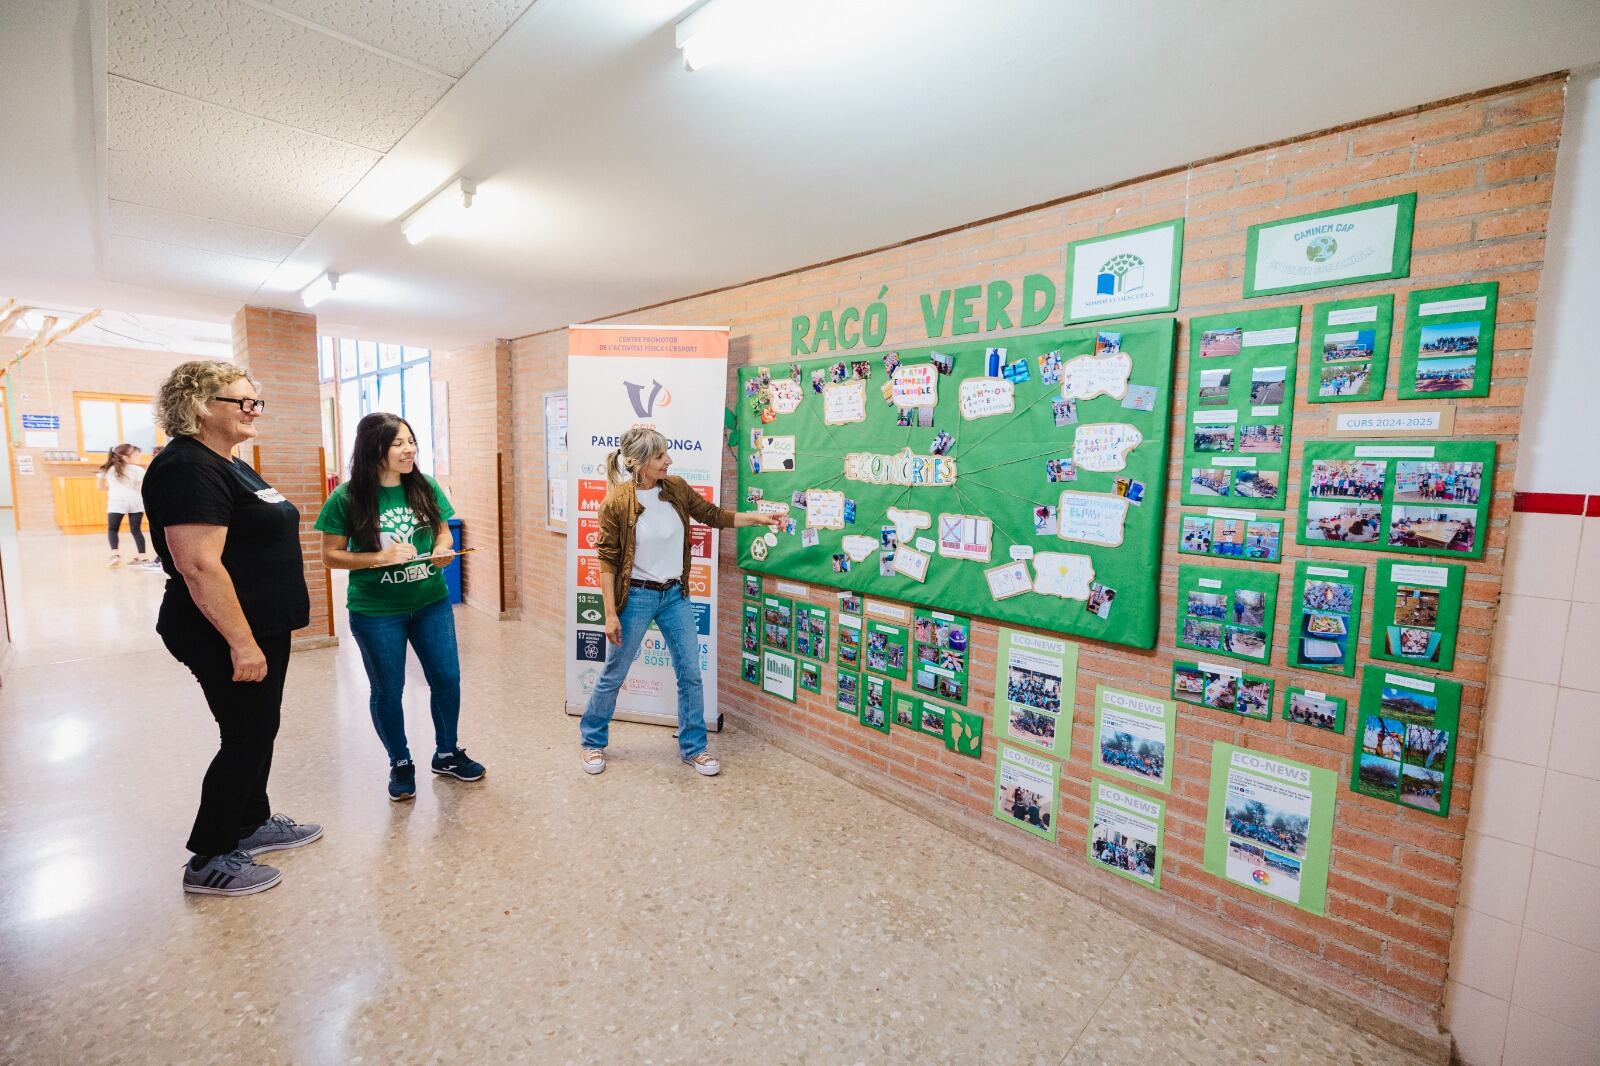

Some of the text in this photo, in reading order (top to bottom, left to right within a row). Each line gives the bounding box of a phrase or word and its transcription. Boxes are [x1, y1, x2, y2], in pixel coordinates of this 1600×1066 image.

[1294, 223, 1355, 242] CAMINEM CAP
[790, 272, 1056, 356] RACÓ VERD
[642, 336, 678, 344] PROMOTOR
[1346, 417, 1433, 428] CURS 2024-2025
[591, 436, 620, 447] PARE
[381, 563, 436, 583] ADEAC
[578, 595, 586, 603] 13
[578, 632, 586, 640] 17
[1013, 635, 1063, 652] ECO-NEWS
[1104, 692, 1163, 716] ECO-NEWS
[1004, 749, 1051, 772] ECO-NEWS
[1233, 753, 1309, 783] ECO-NEWS
[1100, 790, 1159, 815] ECO-NEWS
